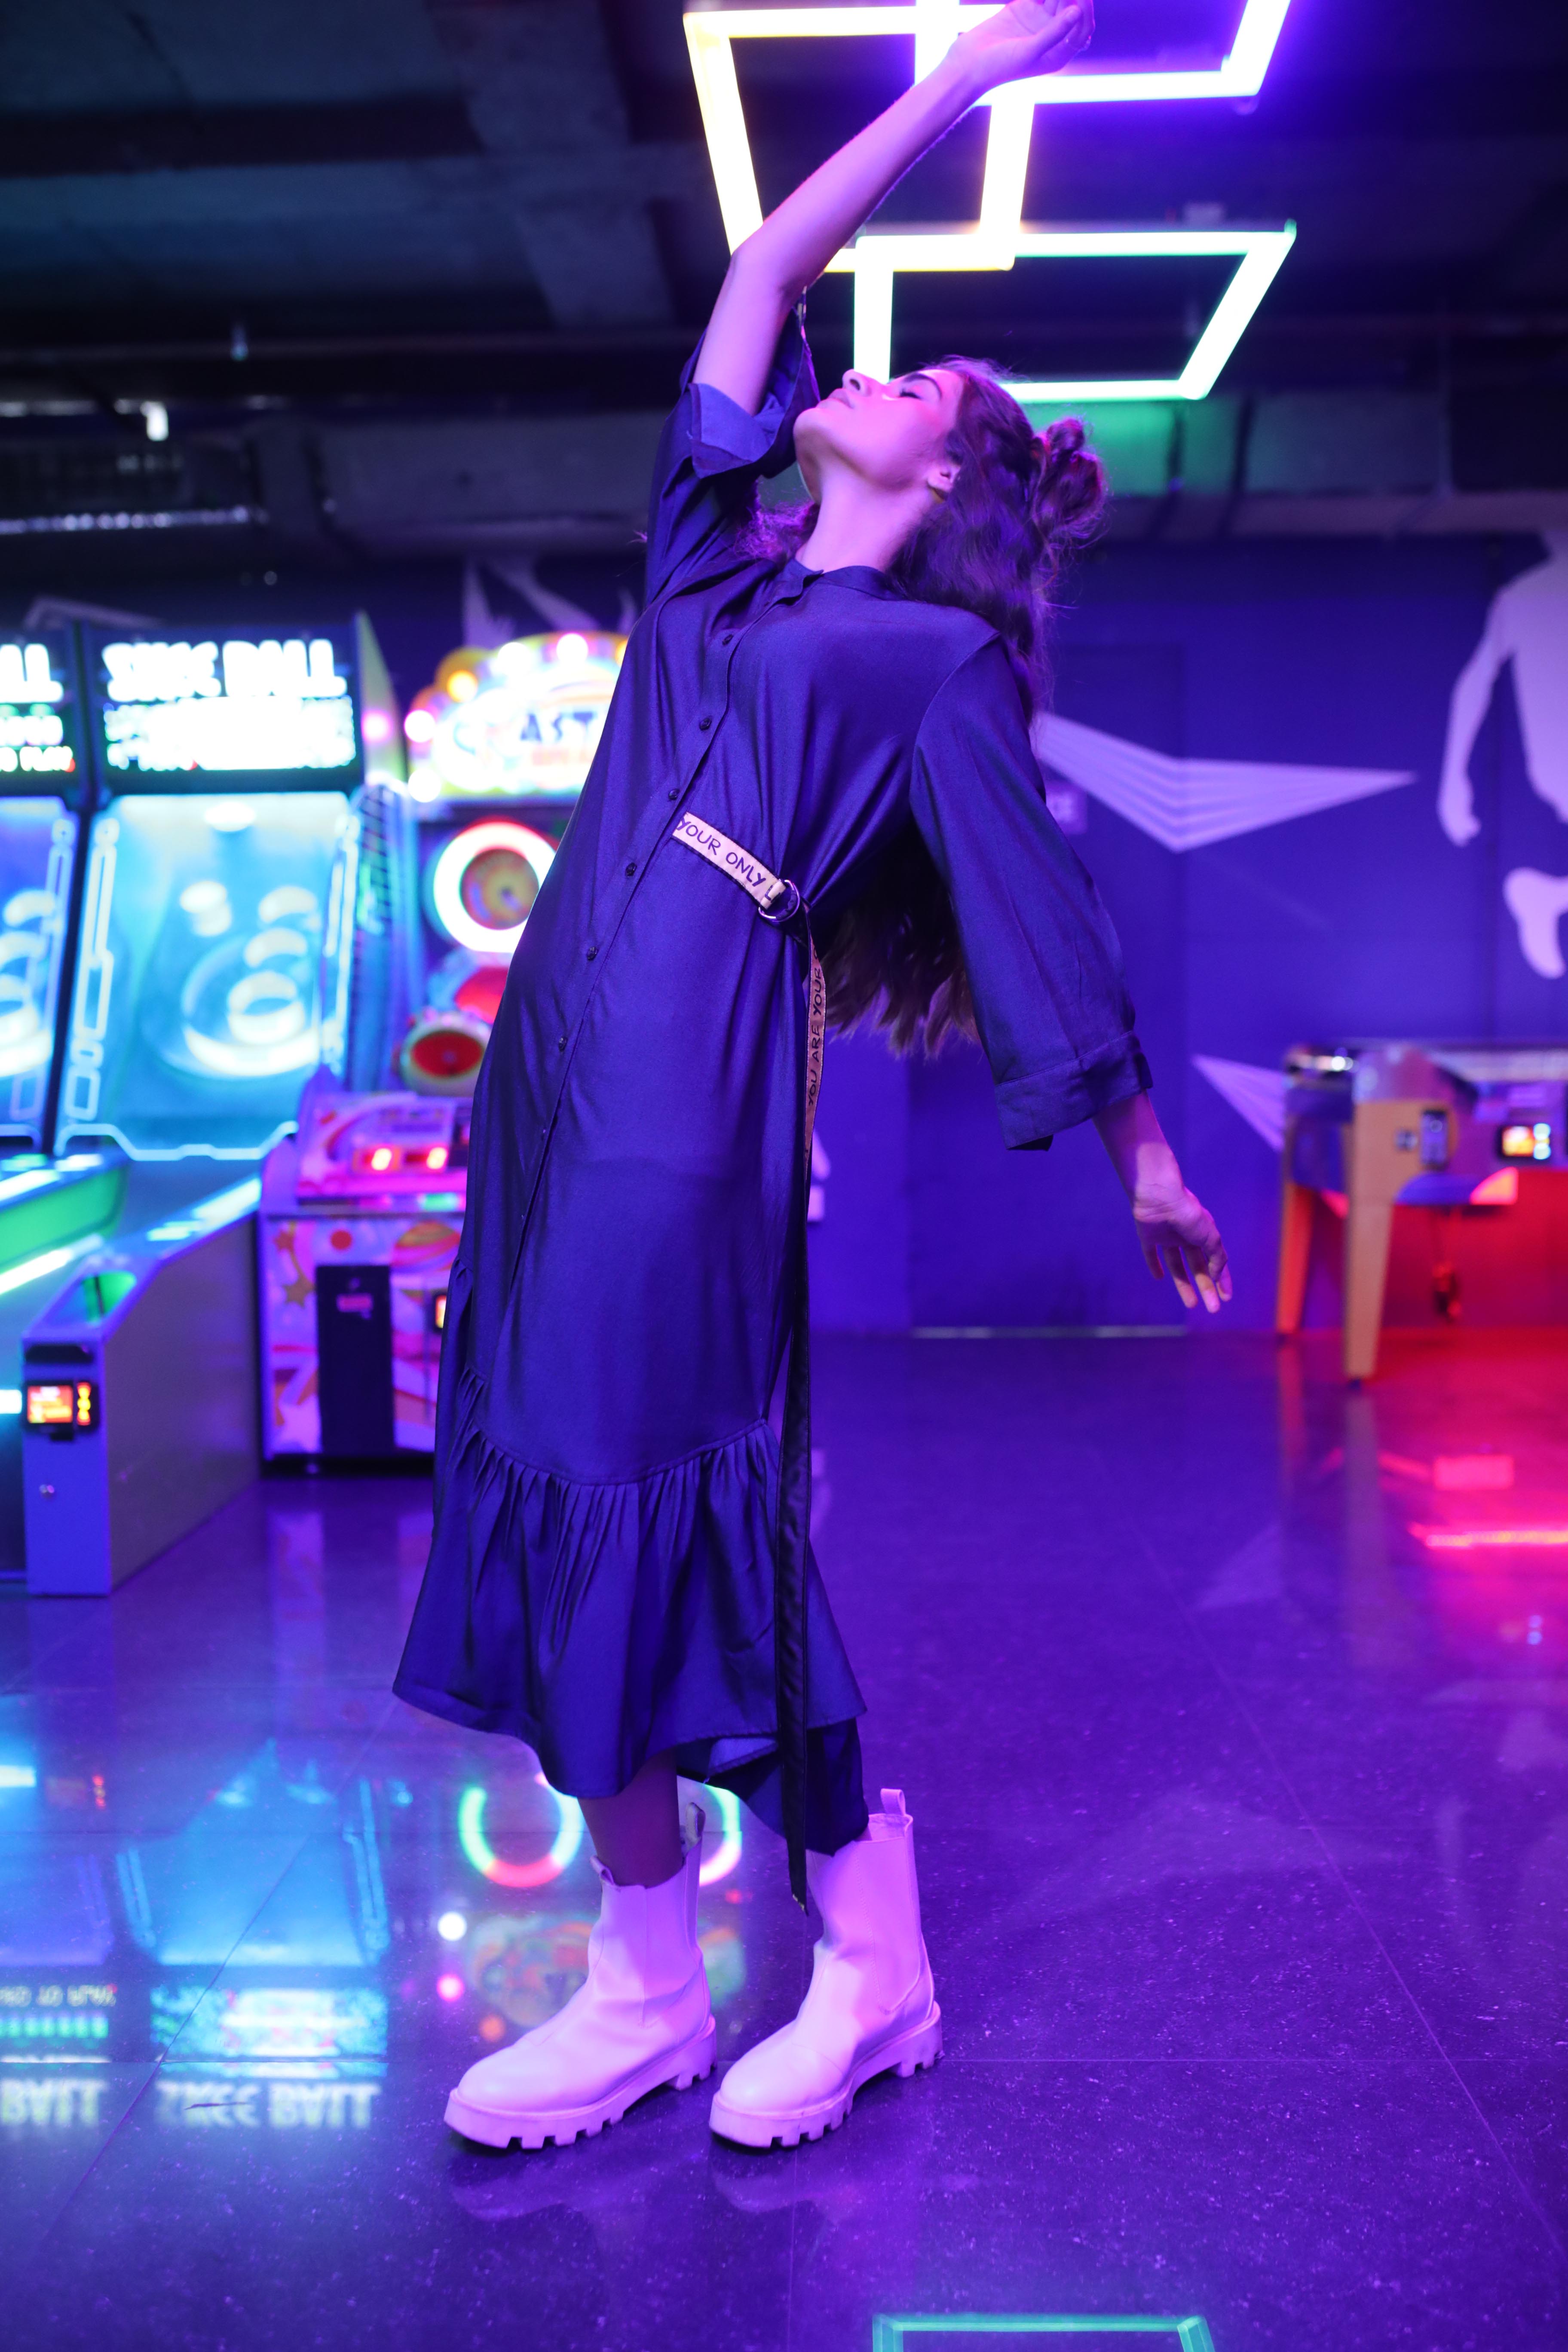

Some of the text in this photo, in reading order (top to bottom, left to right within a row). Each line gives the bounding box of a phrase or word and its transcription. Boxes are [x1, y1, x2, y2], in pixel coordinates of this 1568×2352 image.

[676, 817, 721, 856] YOUR
[726, 852, 766, 887] ONLY
[813, 968, 822, 1016] YOUR
[812, 1025, 821, 1063] ARE
[808, 1069, 817, 1106] YOU
